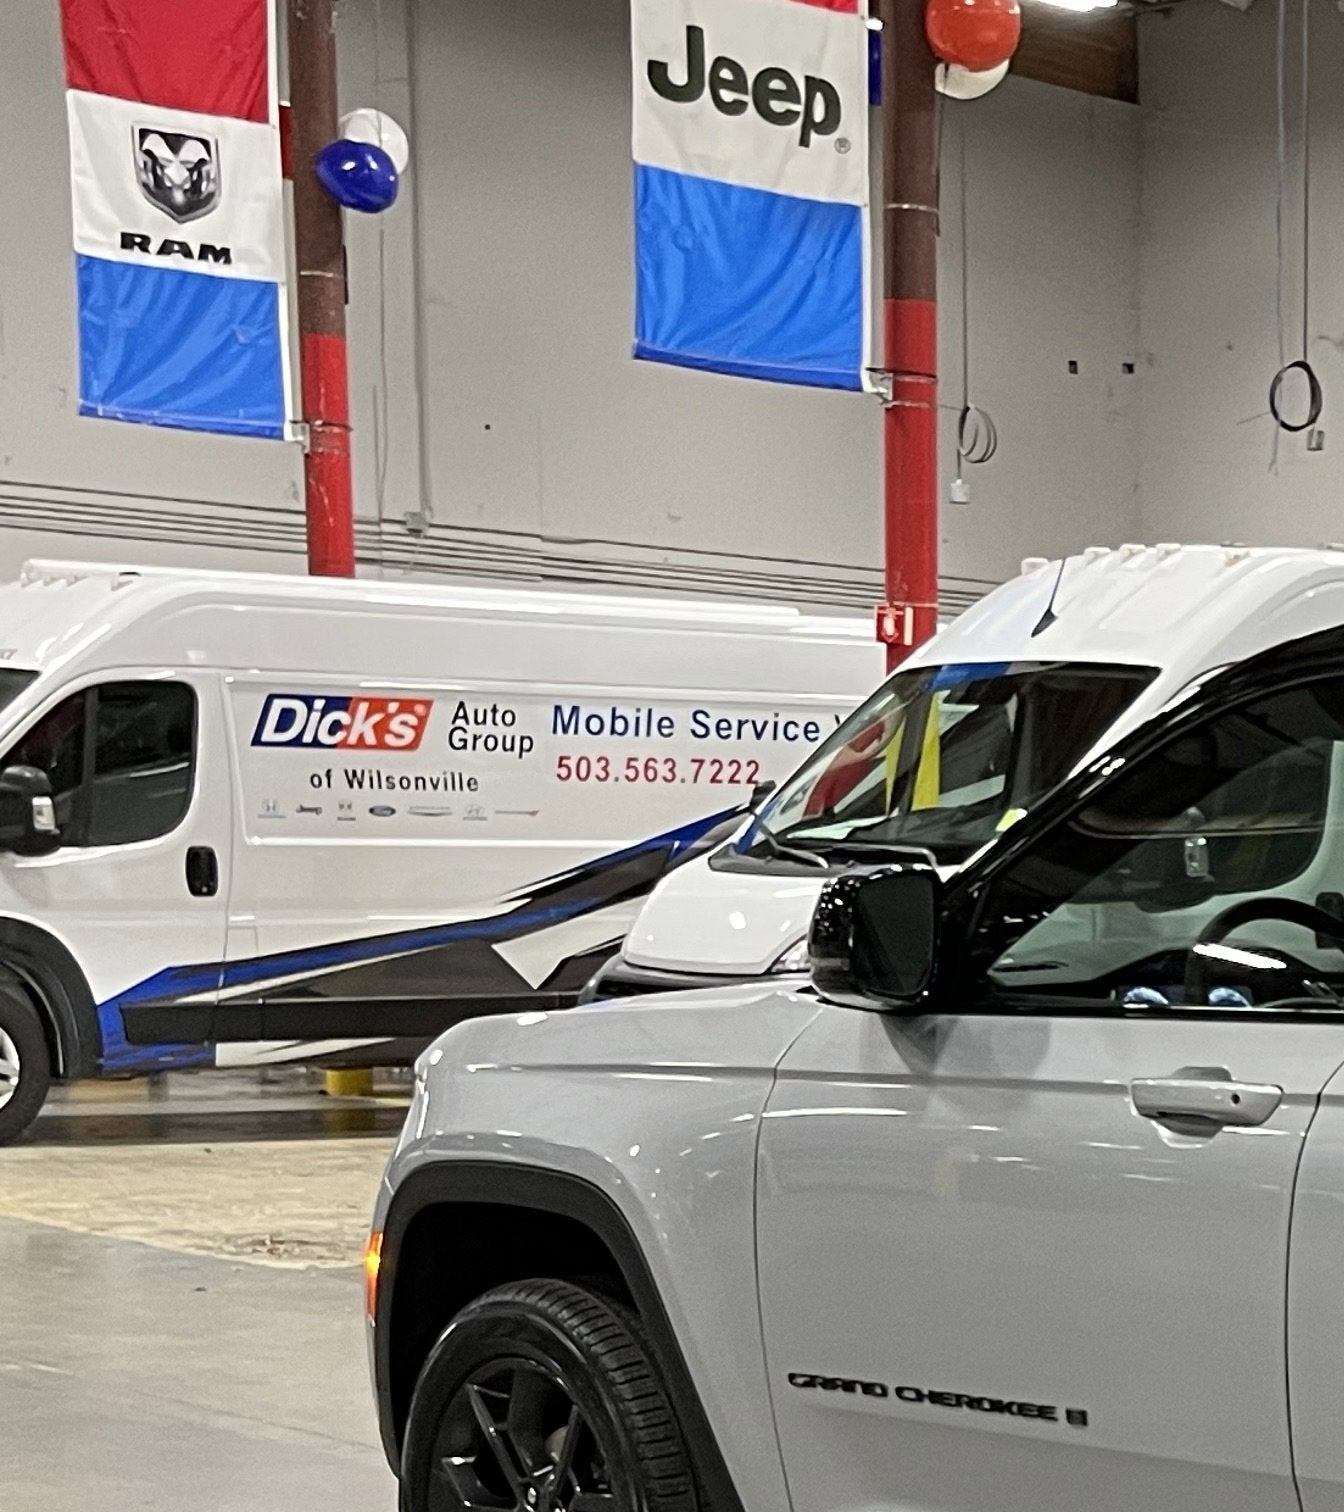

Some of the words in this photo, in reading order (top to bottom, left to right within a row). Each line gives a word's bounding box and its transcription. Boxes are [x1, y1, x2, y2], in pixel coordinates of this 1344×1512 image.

[647, 24, 842, 149] Jeep
[120, 231, 233, 265] RAM
[259, 697, 419, 748] Dick's
[451, 700, 517, 727] Auto
[551, 704, 675, 738] Mobile
[689, 708, 821, 743] Service
[448, 727, 535, 759] Group
[309, 767, 333, 789] of
[344, 768, 480, 793] Wilsonville
[555, 754, 761, 786] 503.563.7222
[787, 1372, 889, 1398] GRAND
[895, 1386, 1059, 1423] CHEROKEE
